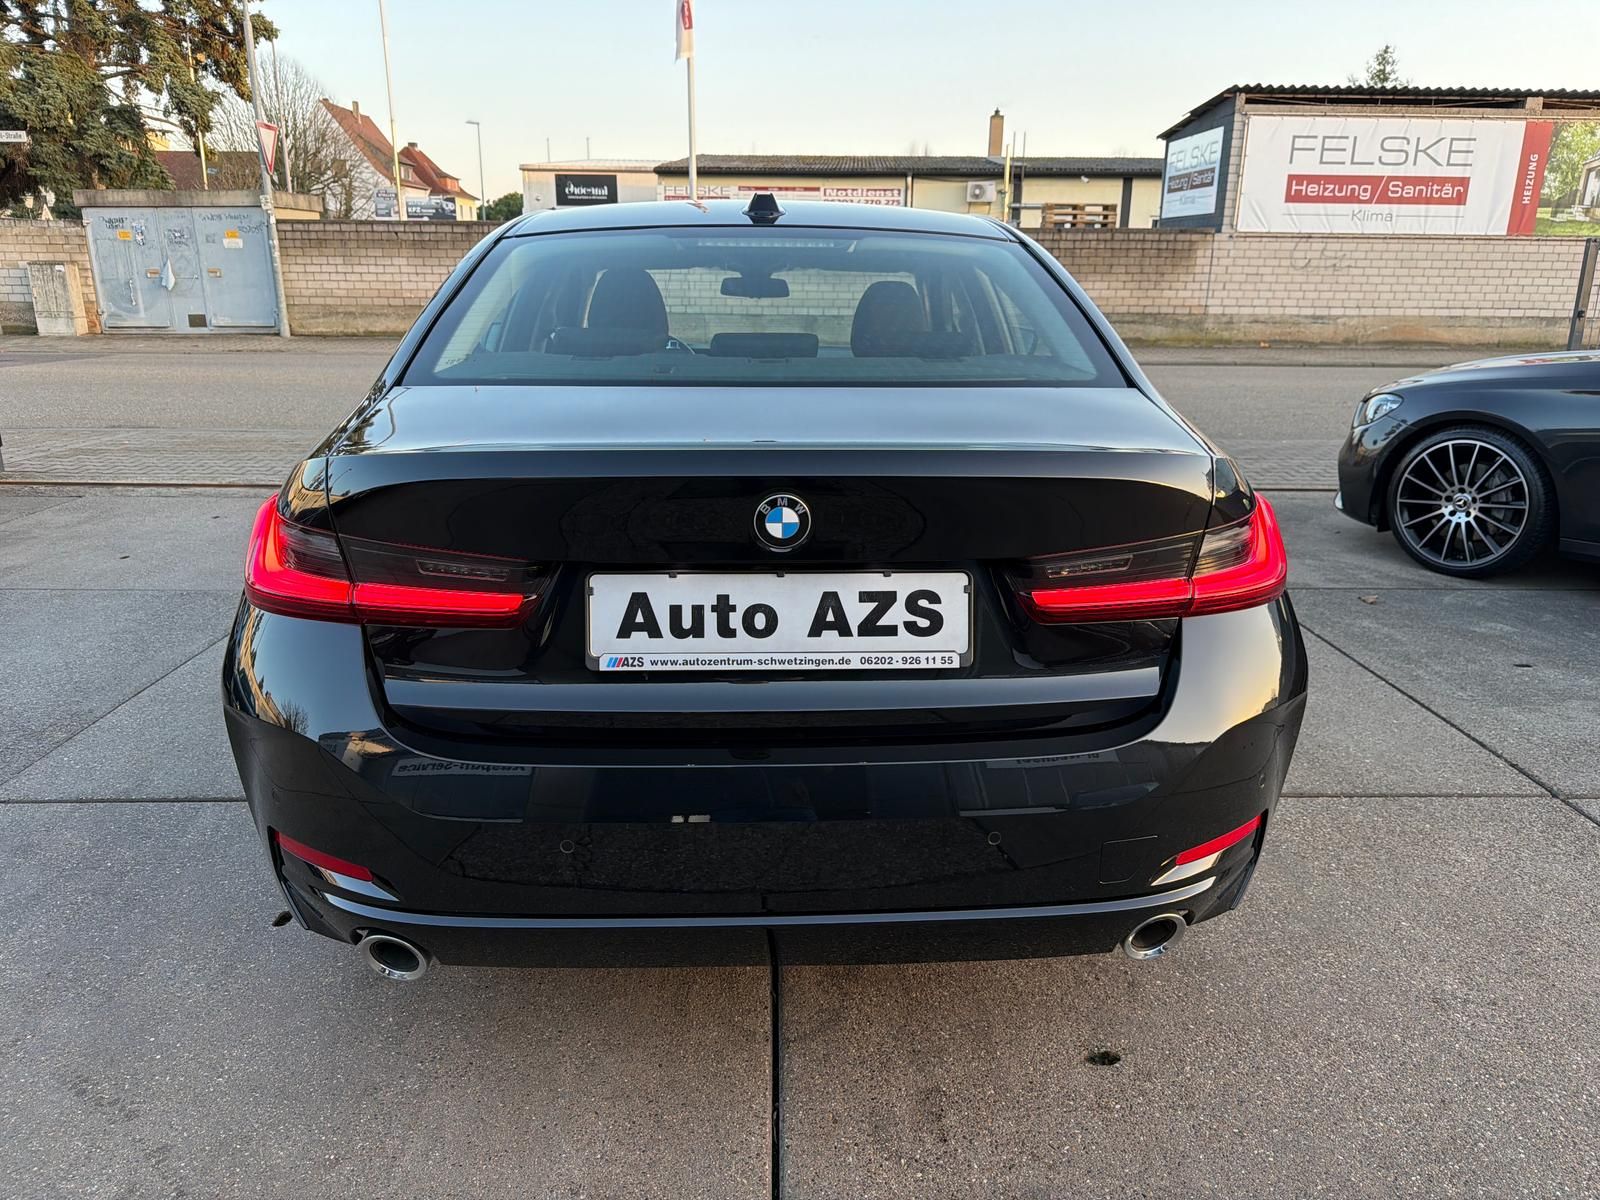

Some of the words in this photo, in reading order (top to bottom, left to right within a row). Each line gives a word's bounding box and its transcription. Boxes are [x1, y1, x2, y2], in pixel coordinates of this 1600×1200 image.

[1168, 140, 1219, 173] FELSKE
[1289, 135, 1477, 167] FELSKE
[1522, 153, 1539, 204] HEIZUNG
[825, 188, 900, 197] Notdienst
[1291, 180, 1372, 200] Heizung
[1388, 181, 1464, 199] Sanitär
[1351, 210, 1394, 223] Klima
[760, 497, 807, 515] BMW
[616, 591, 779, 640] Auto
[807, 589, 944, 638] AZS
[621, 656, 644, 668] AZS
[650, 656, 852, 668] www.autozentrum-schwetzingen.de
[860, 656, 894, 665] 06202
[901, 656, 922, 665] 926
[925, 656, 936, 665] 11
[940, 656, 954, 665] 55
